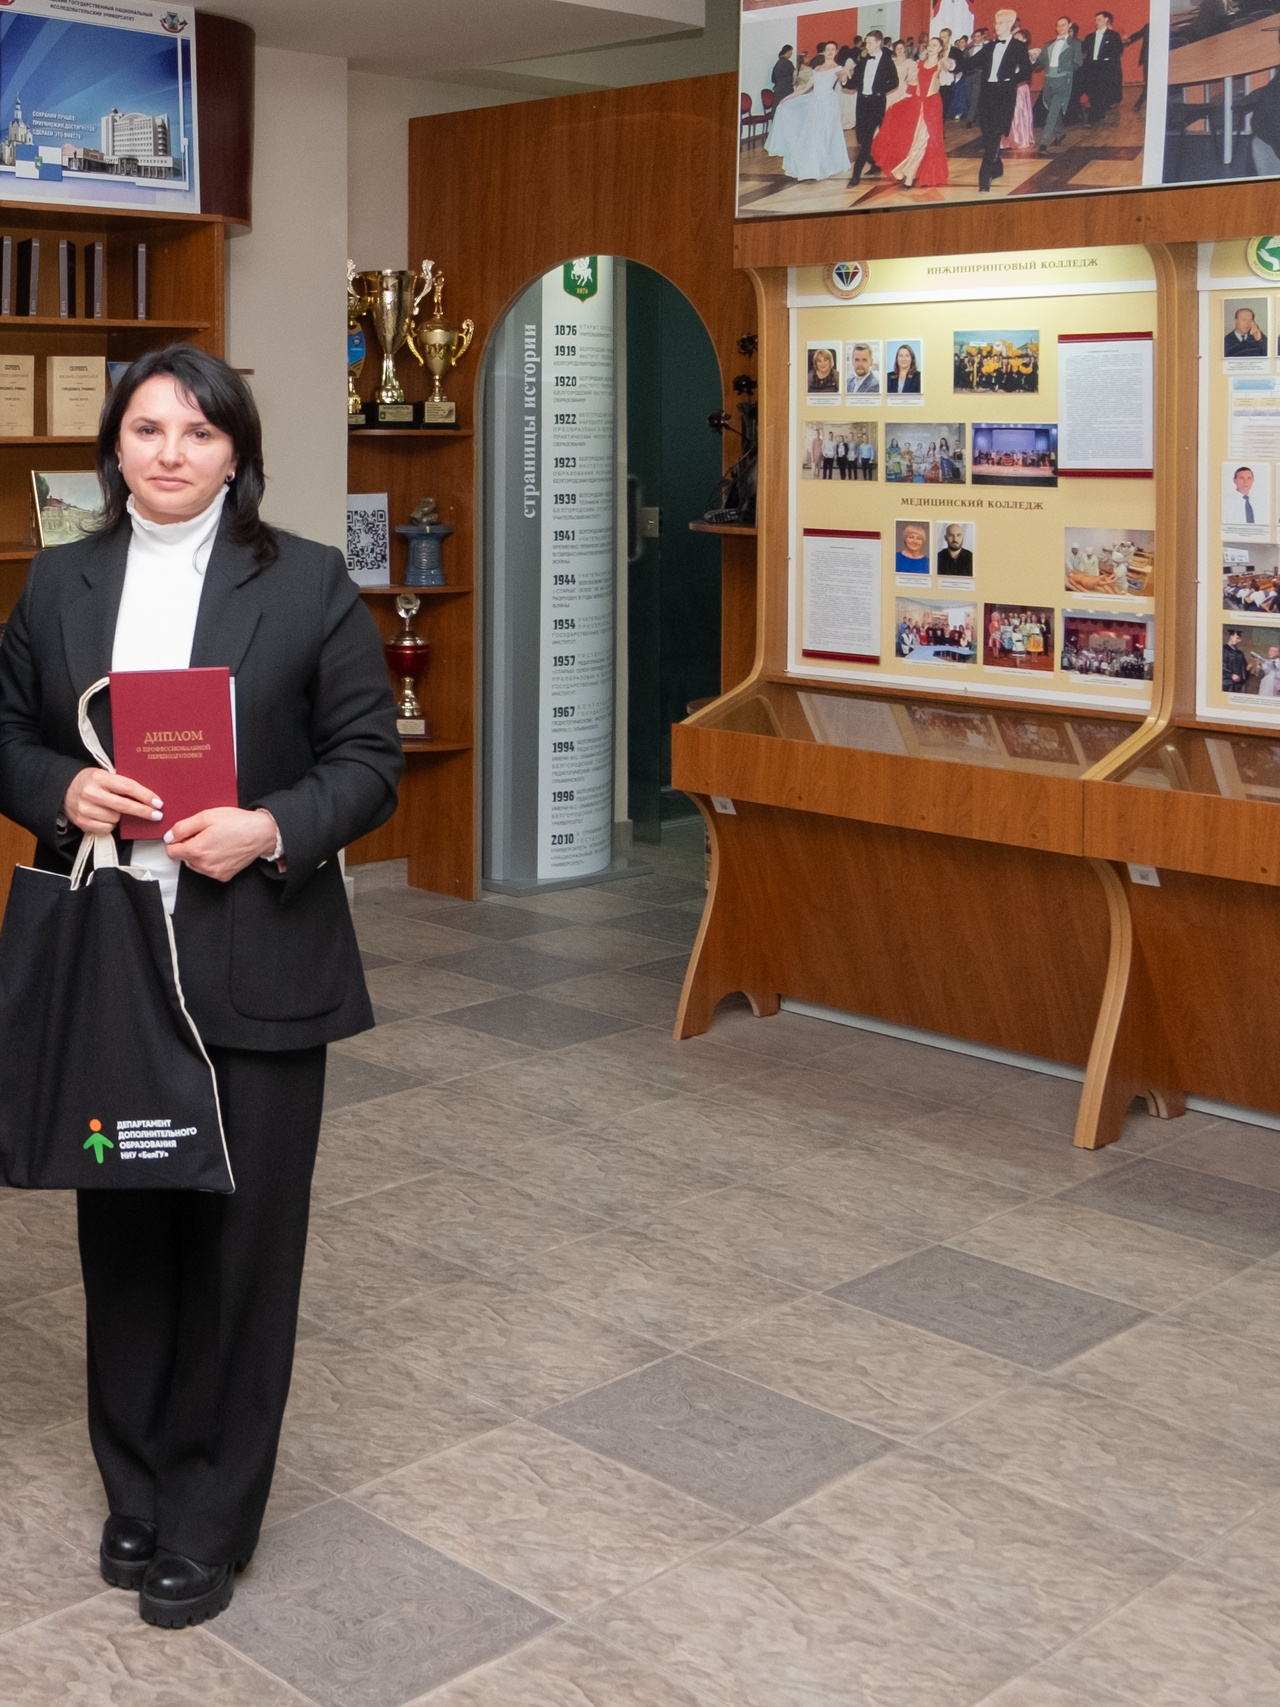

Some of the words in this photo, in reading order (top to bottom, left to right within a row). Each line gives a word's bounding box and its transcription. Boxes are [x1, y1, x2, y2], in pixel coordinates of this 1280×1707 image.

[927, 260, 1037, 275] ИНЖИНИРИНГОВЫЙ
[1041, 257, 1098, 269] КОЛЛЕДЖ
[554, 325, 577, 336] 1876
[554, 345, 576, 356] 1919
[523, 324, 540, 408] истории
[554, 376, 577, 387] 1920
[554, 413, 577, 424] 1922
[523, 415, 540, 519] страницы
[554, 457, 577, 468] 1923
[553, 493, 576, 504] 1939
[900, 497, 984, 508] МЕДИЦИНСКИЙ
[987, 500, 1044, 510] КОЛЛЕДЖ
[553, 530, 575, 541] 1941
[553, 574, 576, 585] 1944
[553, 619, 575, 630] 1954
[553, 655, 575, 666] 1957
[553, 706, 575, 718] 1967
[144, 730, 203, 745] ДИПЛОМ
[552, 741, 575, 753] 1994
[552, 790, 575, 802] 1996
[551, 833, 574, 845] 2010
[116, 1119, 171, 1130] ДЕПАРТАМЕНТ
[118, 1127, 198, 1140] ДОПОЛНИТЕЛЬНОГО
[119, 1140, 177, 1149] ОБРАЗОВАНИЯ
[120, 1151, 137, 1159] НИУ
